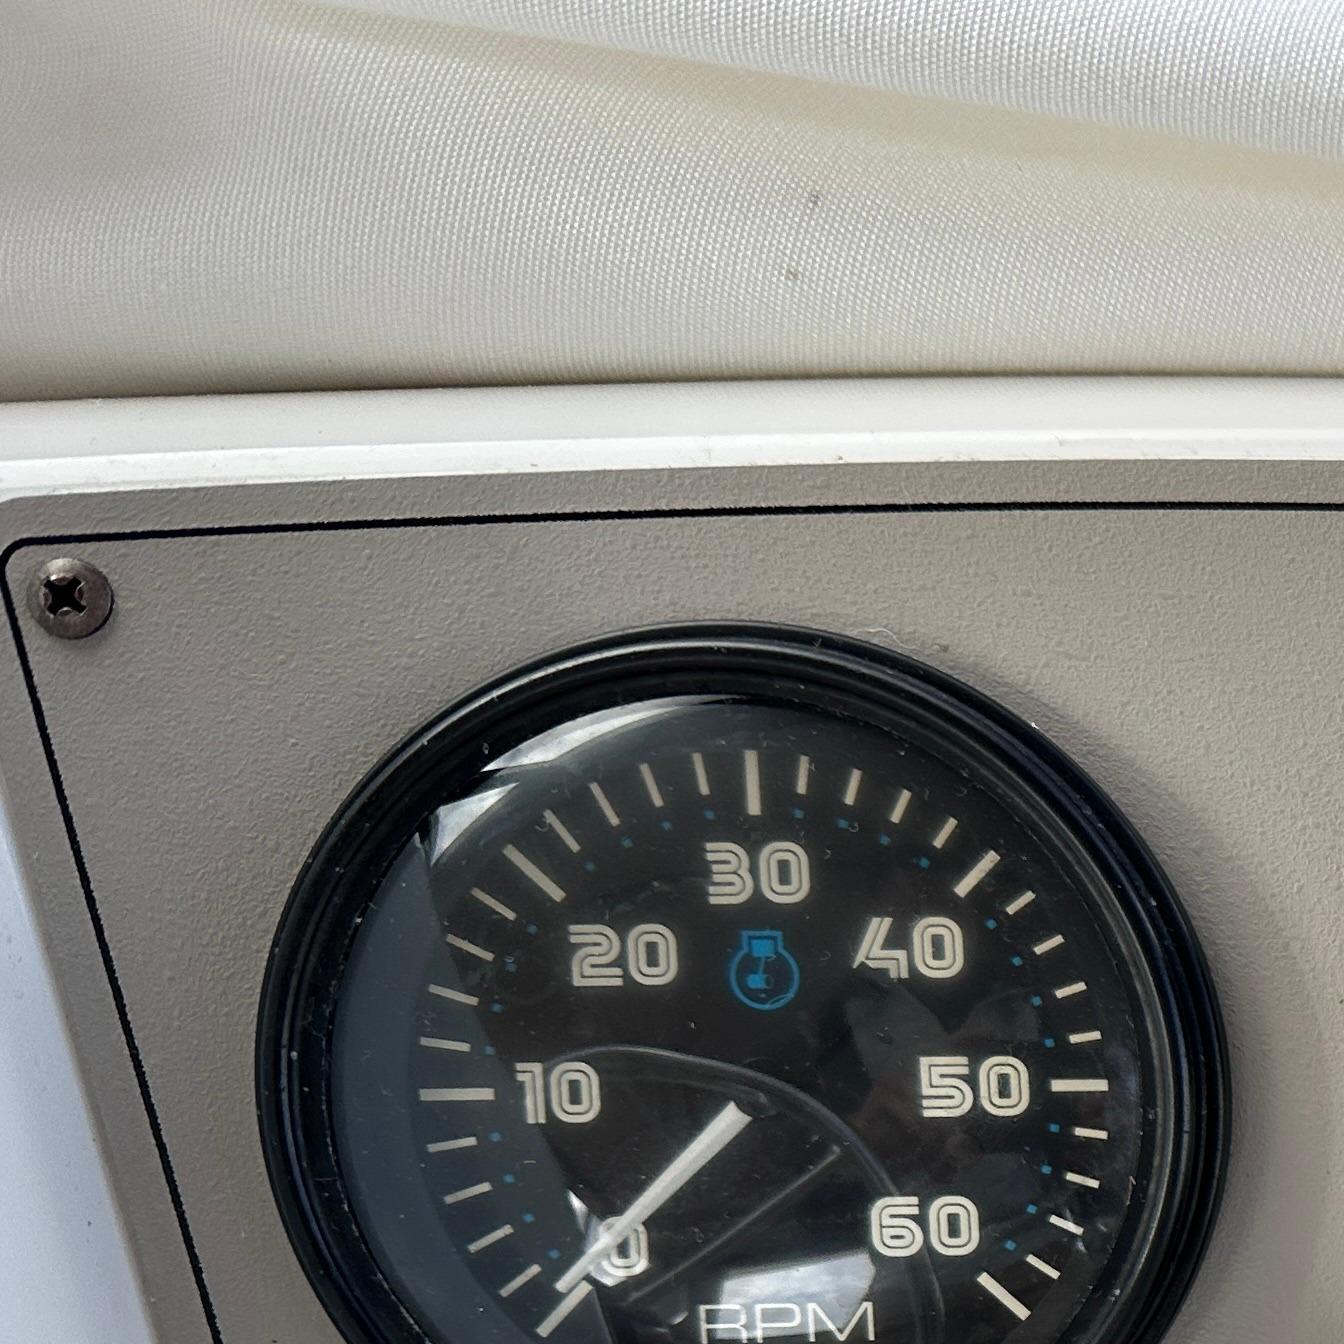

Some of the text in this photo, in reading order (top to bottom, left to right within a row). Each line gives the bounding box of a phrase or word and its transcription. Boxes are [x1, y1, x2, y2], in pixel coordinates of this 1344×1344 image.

[705, 842, 811, 905] 30
[569, 924, 678, 986] 20
[854, 917, 965, 980] 40
[516, 1062, 599, 1123] 10
[919, 1056, 1030, 1117] 50
[600, 1216, 649, 1276] 0
[870, 1197, 979, 1256] 60
[699, 1301, 875, 1344] RPM
